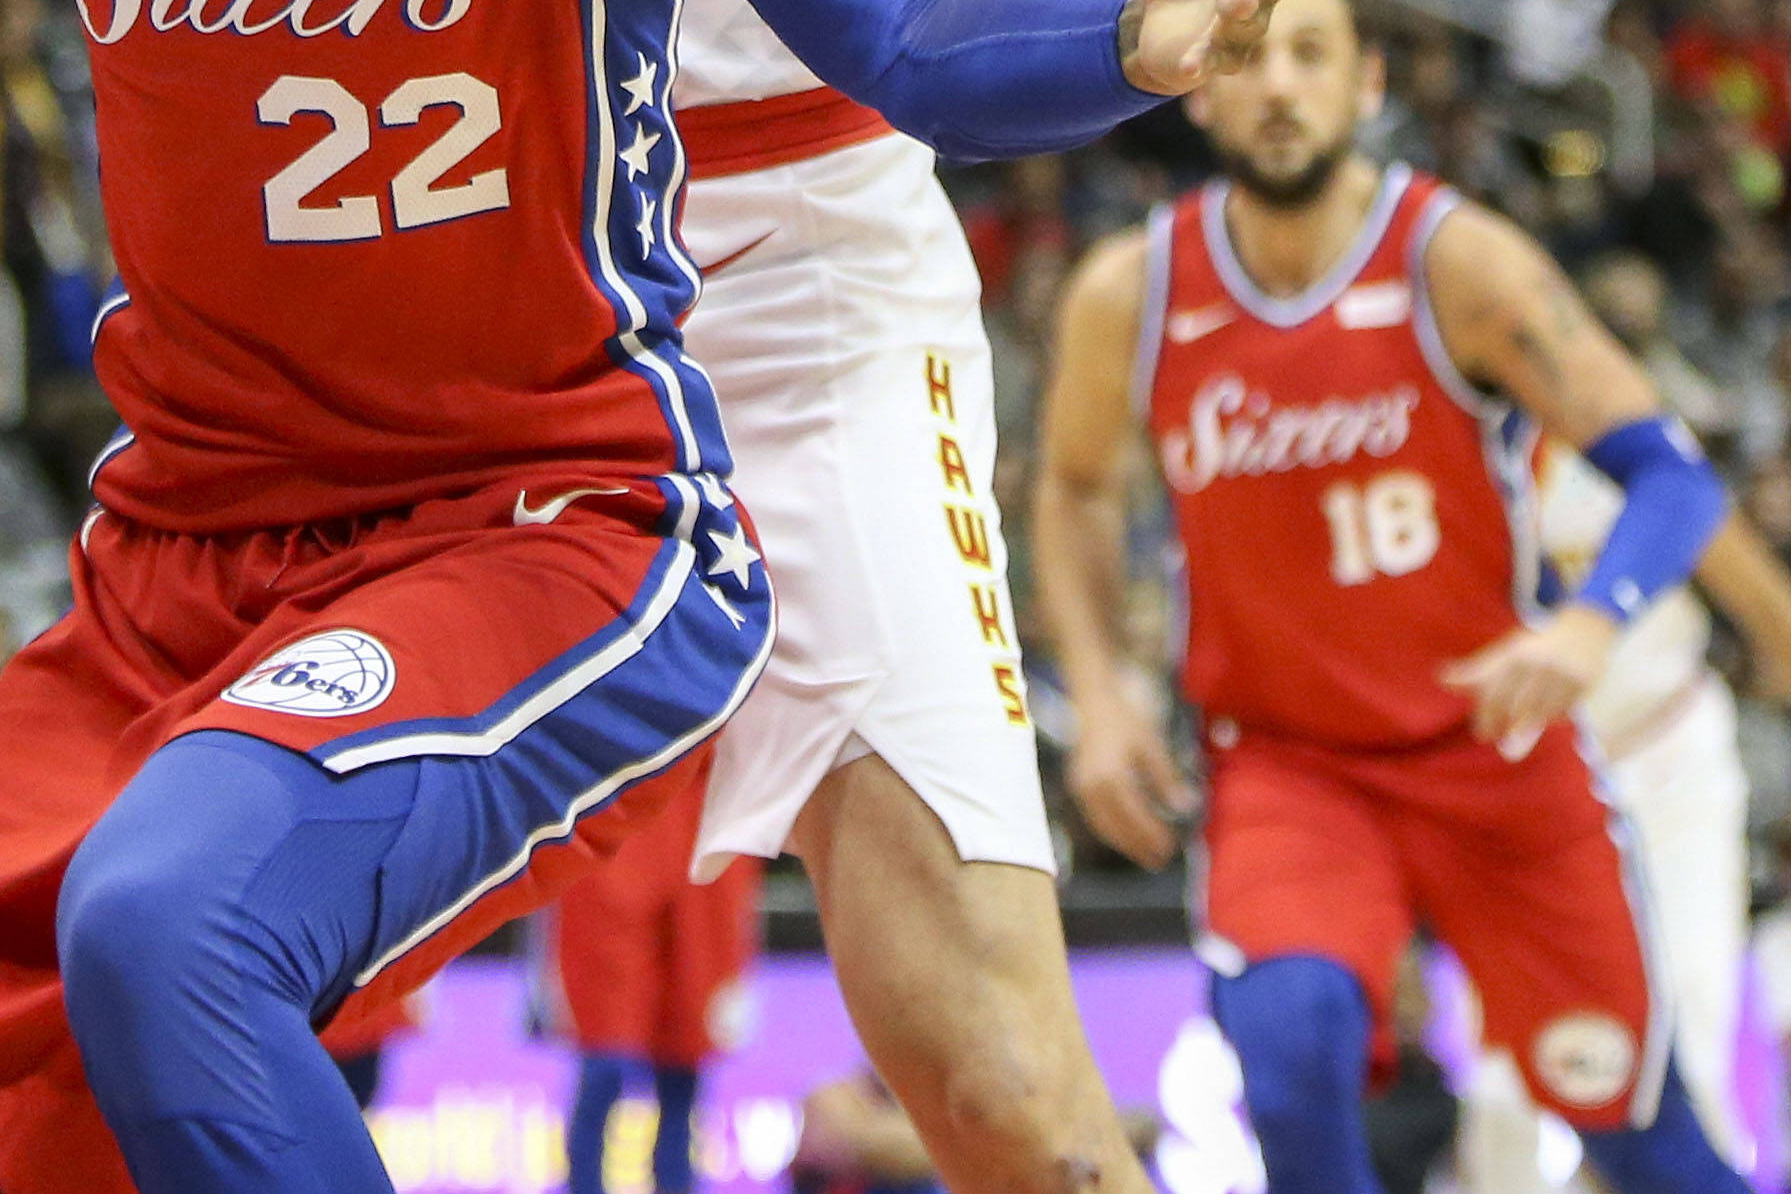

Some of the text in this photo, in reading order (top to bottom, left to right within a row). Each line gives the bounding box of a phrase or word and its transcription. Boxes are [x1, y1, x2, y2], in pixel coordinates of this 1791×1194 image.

[256, 72, 510, 244] 22
[923, 349, 1032, 729] HAWKS
[1321, 472, 1442, 587] 18
